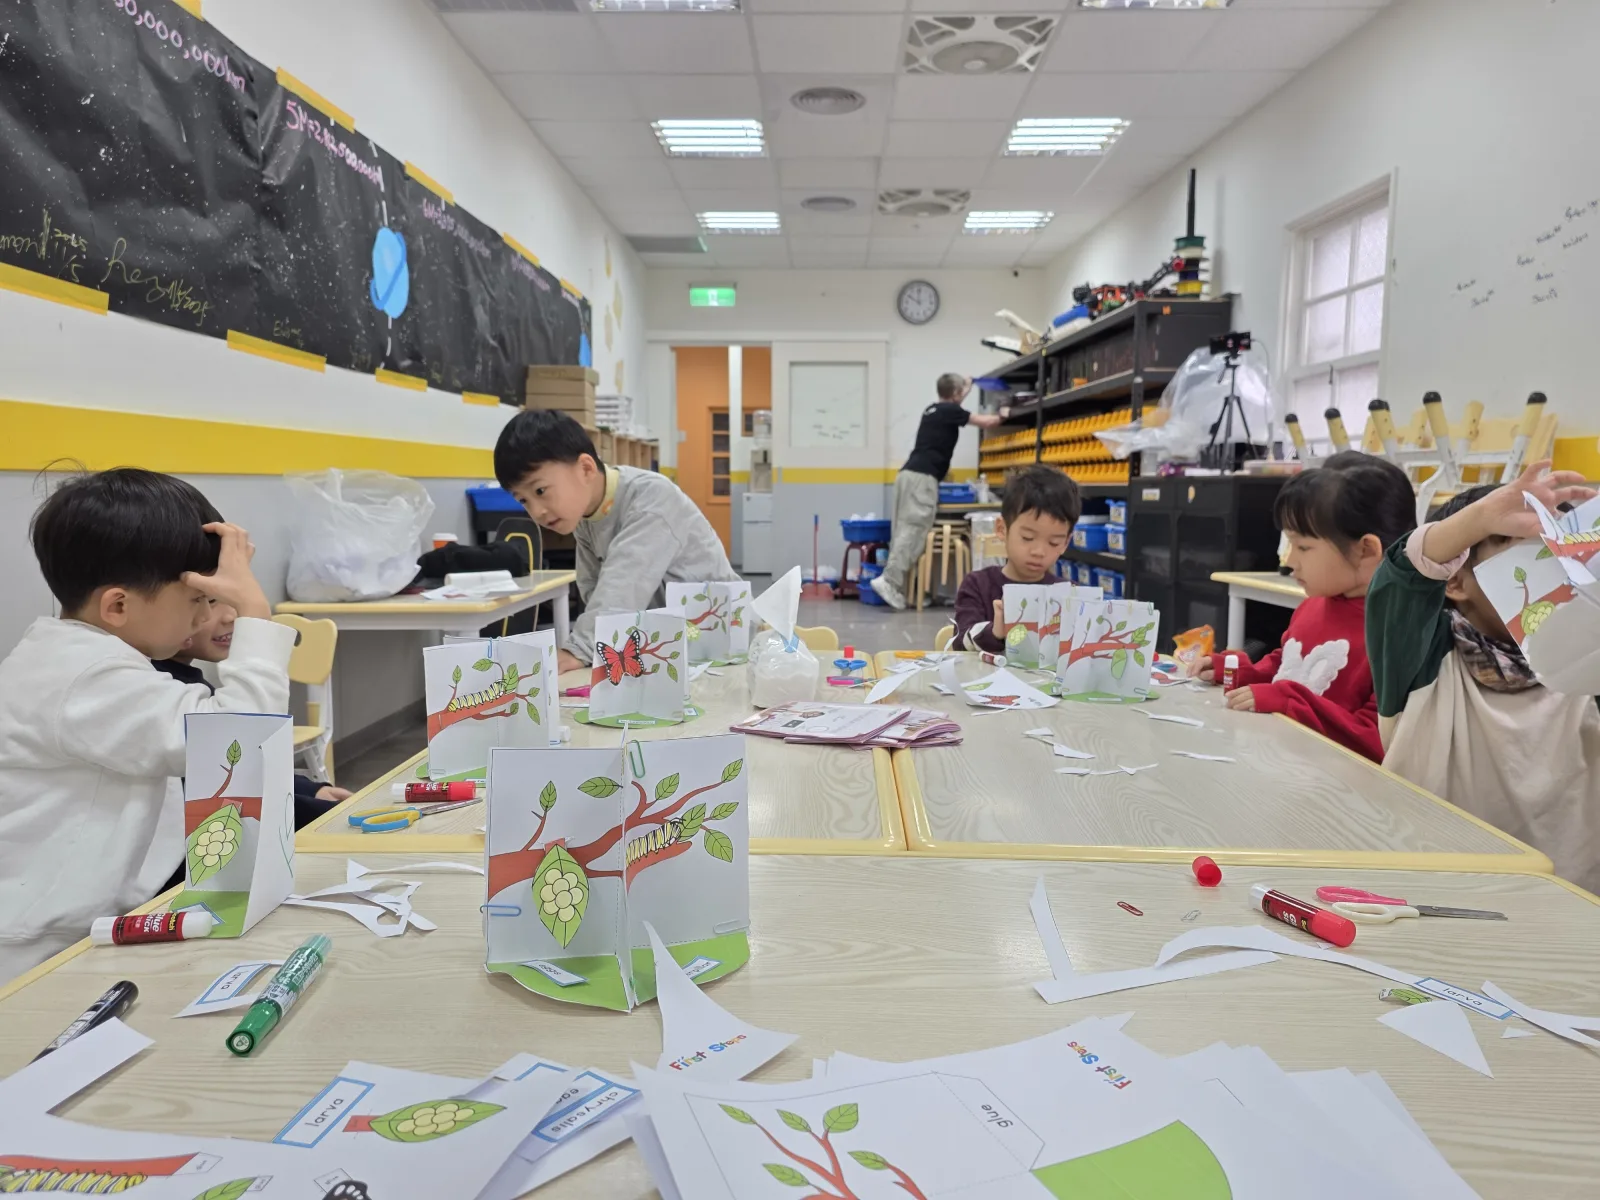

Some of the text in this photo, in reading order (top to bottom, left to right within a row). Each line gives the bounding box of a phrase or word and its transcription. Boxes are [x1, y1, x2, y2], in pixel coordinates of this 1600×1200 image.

[1442, 987, 1484, 1006] larva
[669, 1034, 747, 1071] First Steps
[1066, 1041, 1133, 1089] First Steps
[304, 1097, 345, 1128] larva
[550, 1090, 619, 1134] chrysalis
[981, 1103, 1014, 1129] glue
